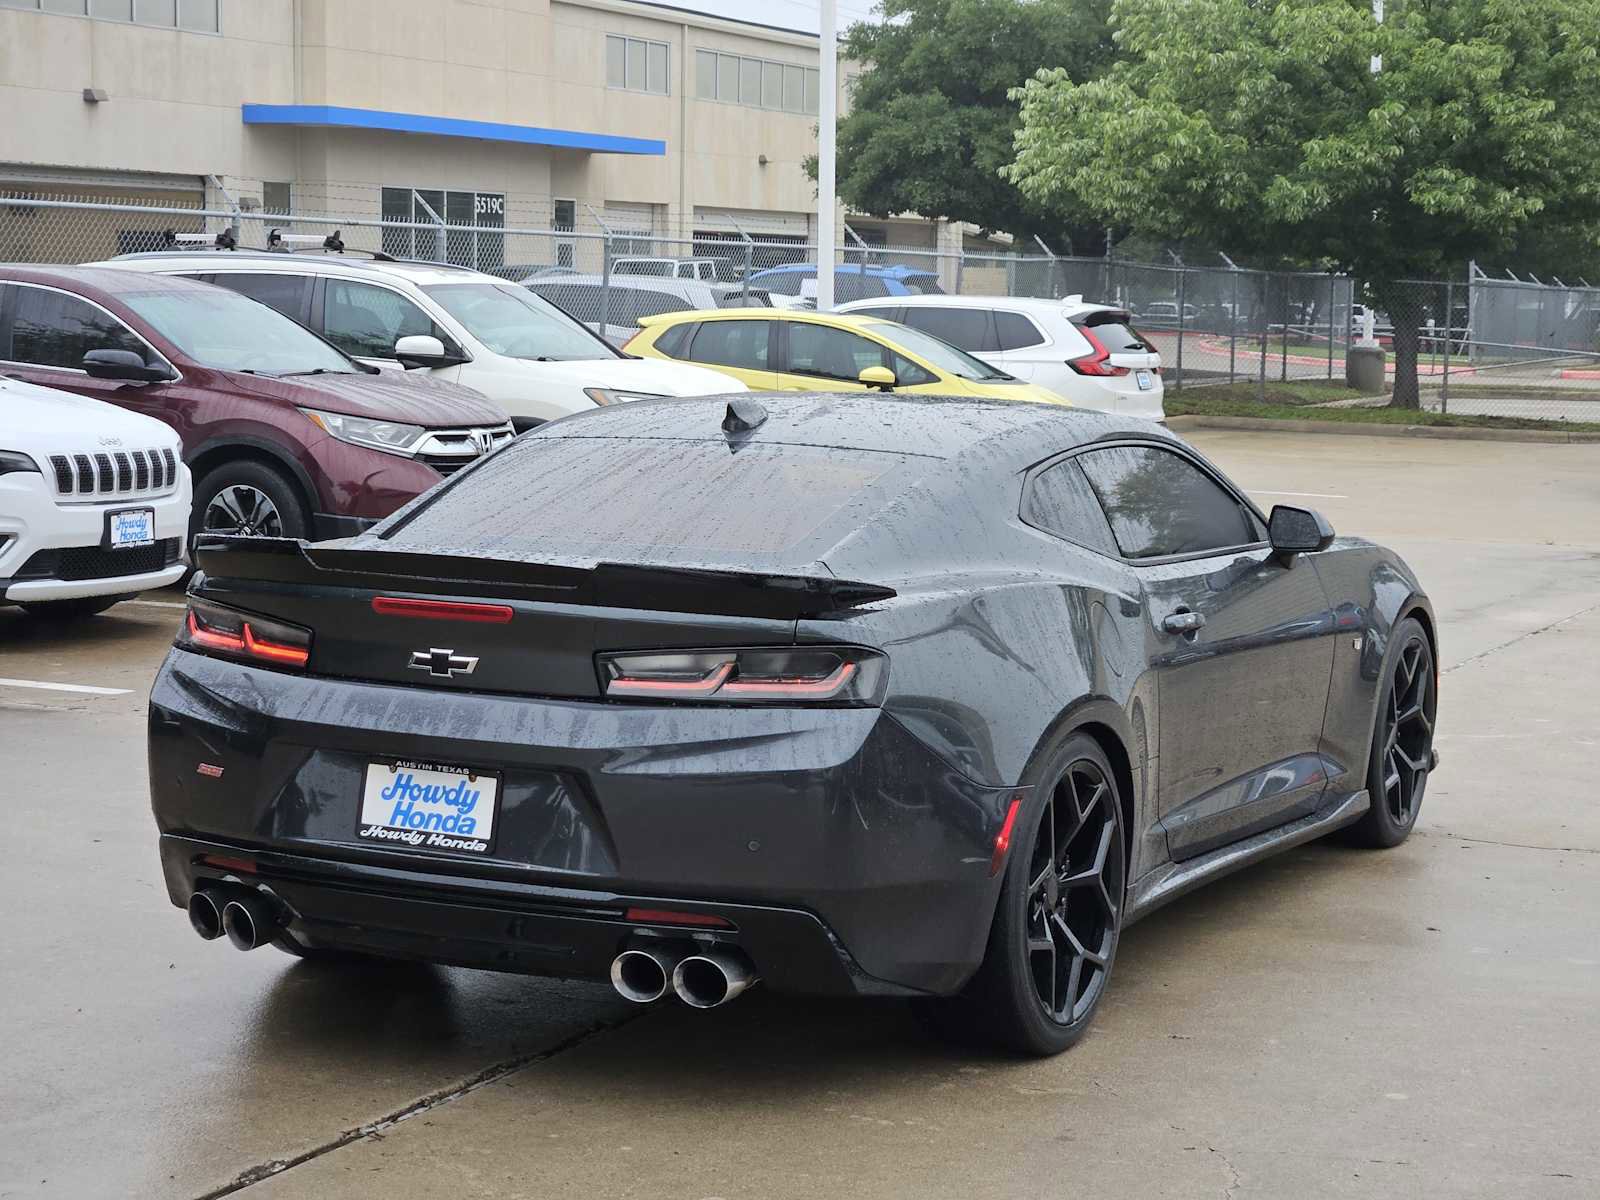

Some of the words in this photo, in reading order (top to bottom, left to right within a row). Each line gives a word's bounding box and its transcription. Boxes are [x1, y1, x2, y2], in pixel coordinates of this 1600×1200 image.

[116, 515, 147, 531] Howdy
[119, 529, 148, 542] Honda
[396, 760, 432, 770] AUSTIN
[437, 765, 470, 774] TEXAS
[381, 773, 481, 815] Howdy
[389, 801, 477, 835] Honda
[360, 825, 425, 845] Howdy
[426, 834, 488, 851] Honda
